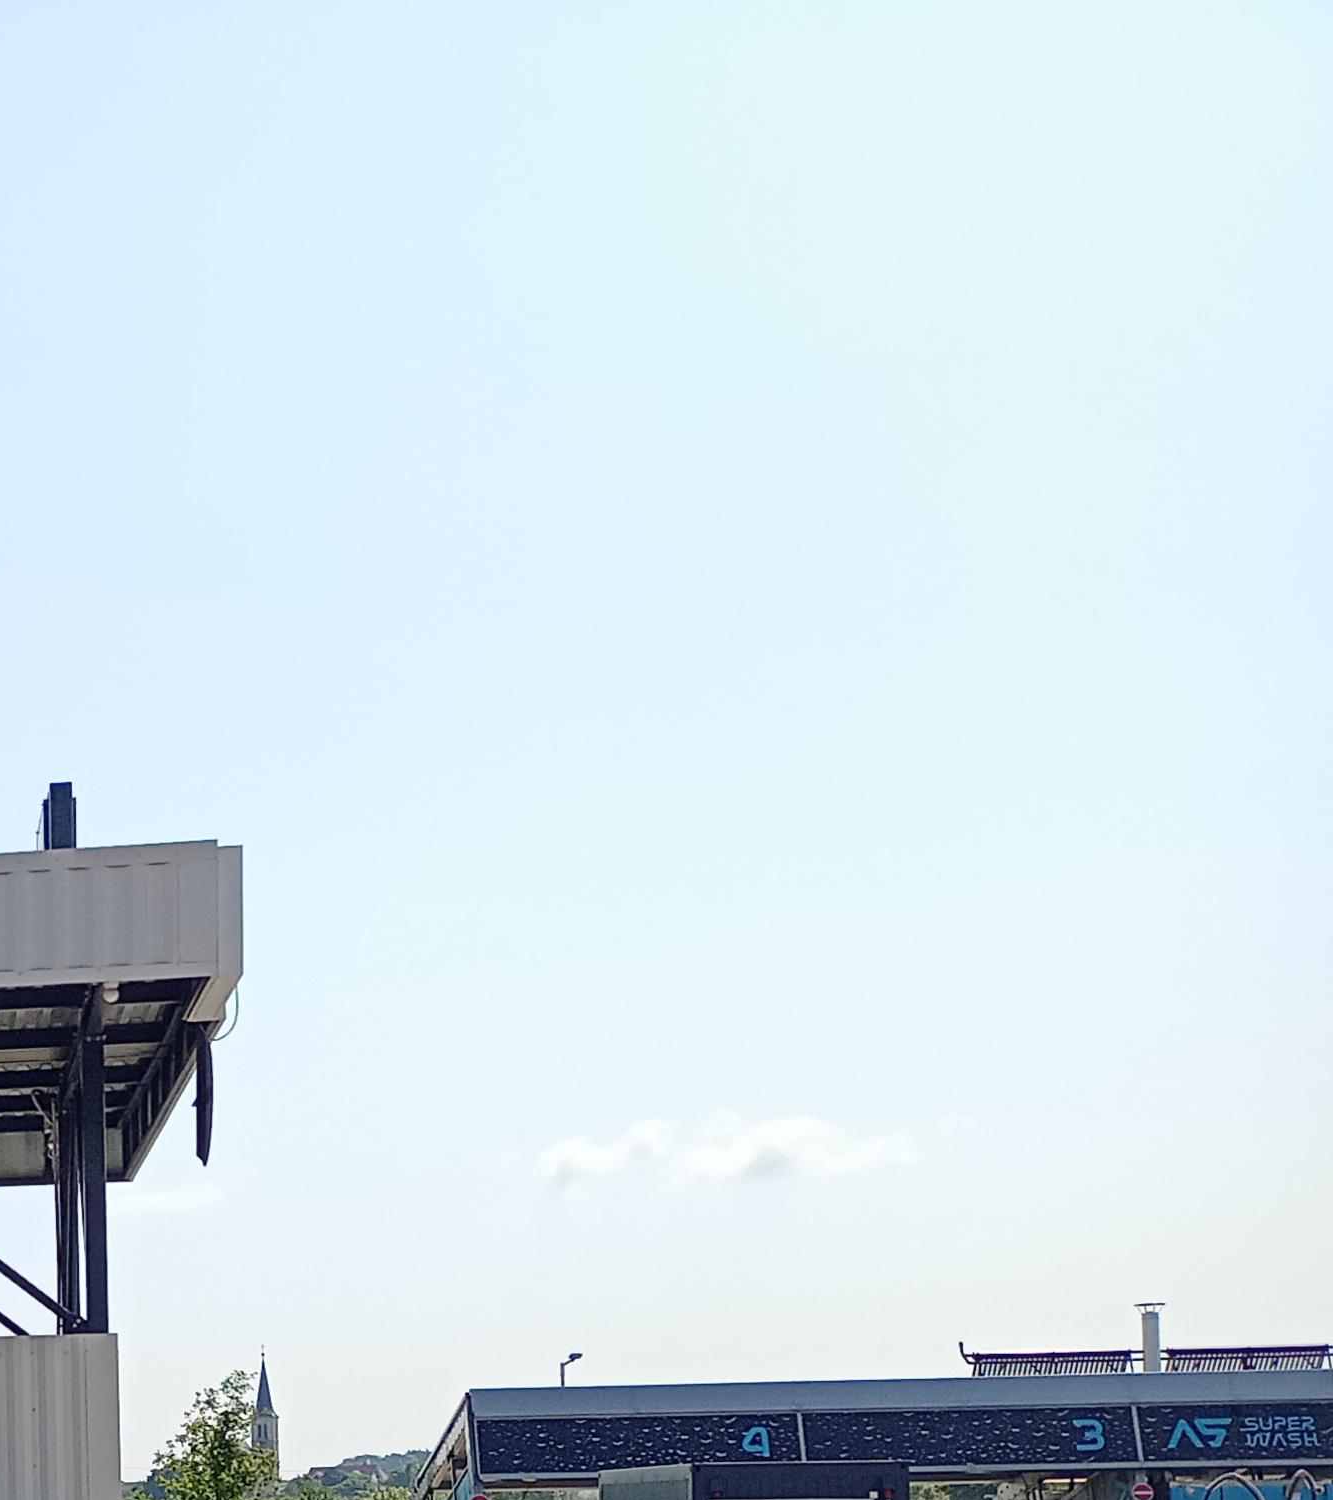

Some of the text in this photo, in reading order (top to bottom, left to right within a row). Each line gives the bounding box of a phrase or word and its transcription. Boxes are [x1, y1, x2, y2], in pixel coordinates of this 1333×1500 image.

[1239, 1416, 1316, 1431] SUPER
[1072, 1419, 1105, 1451] 3
[1244, 1431, 1321, 1447] WASH
